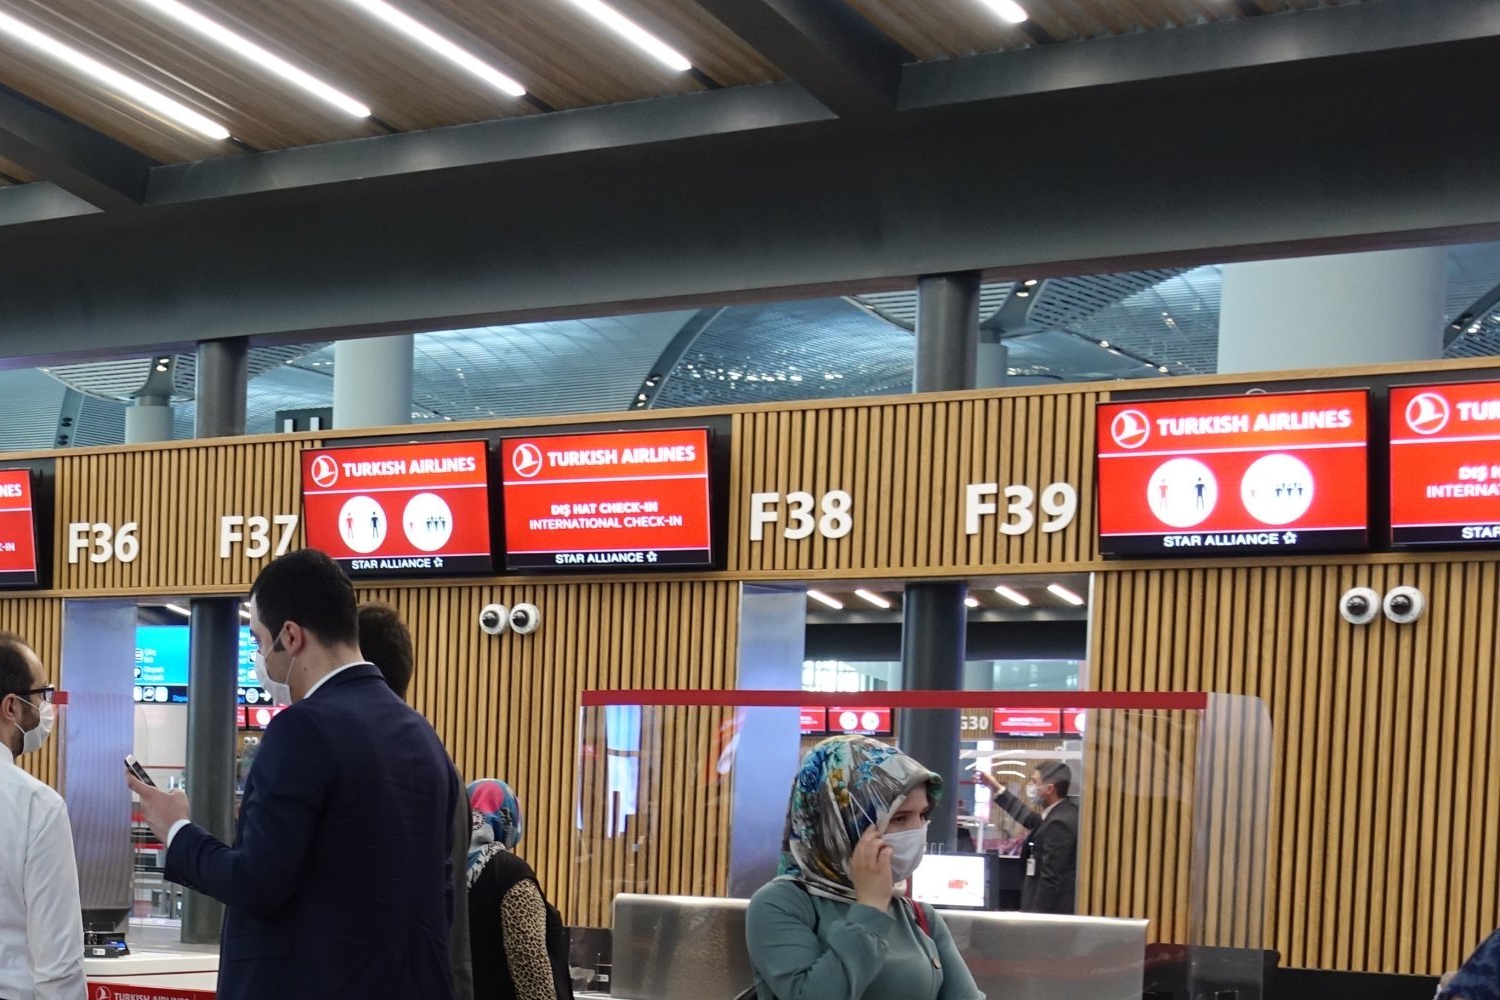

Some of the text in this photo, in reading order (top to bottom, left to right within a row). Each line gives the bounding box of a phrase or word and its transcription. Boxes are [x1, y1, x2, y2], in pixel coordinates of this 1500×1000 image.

[1156, 409, 1352, 437] TURKISH AIRLINES
[342, 456, 476, 478] TURKISH AIRLINES
[548, 445, 696, 467] TURKISH AIRLINES
[1426, 483, 1500, 499] INTERNA
[551, 501, 659, 517] DIŞ HAT CHECK-IN
[749, 488, 853, 541] F38
[965, 481, 1077, 537] F39
[529, 515, 683, 530] INTERNATIONAL CHECK-IN
[68, 521, 140, 564] F36
[220, 514, 299, 559] F37
[1163, 533, 1280, 548] STAR ALLIANCE
[351, 557, 431, 570] STAR ALLIANCE
[555, 552, 644, 564] STAR ALLIANCE
